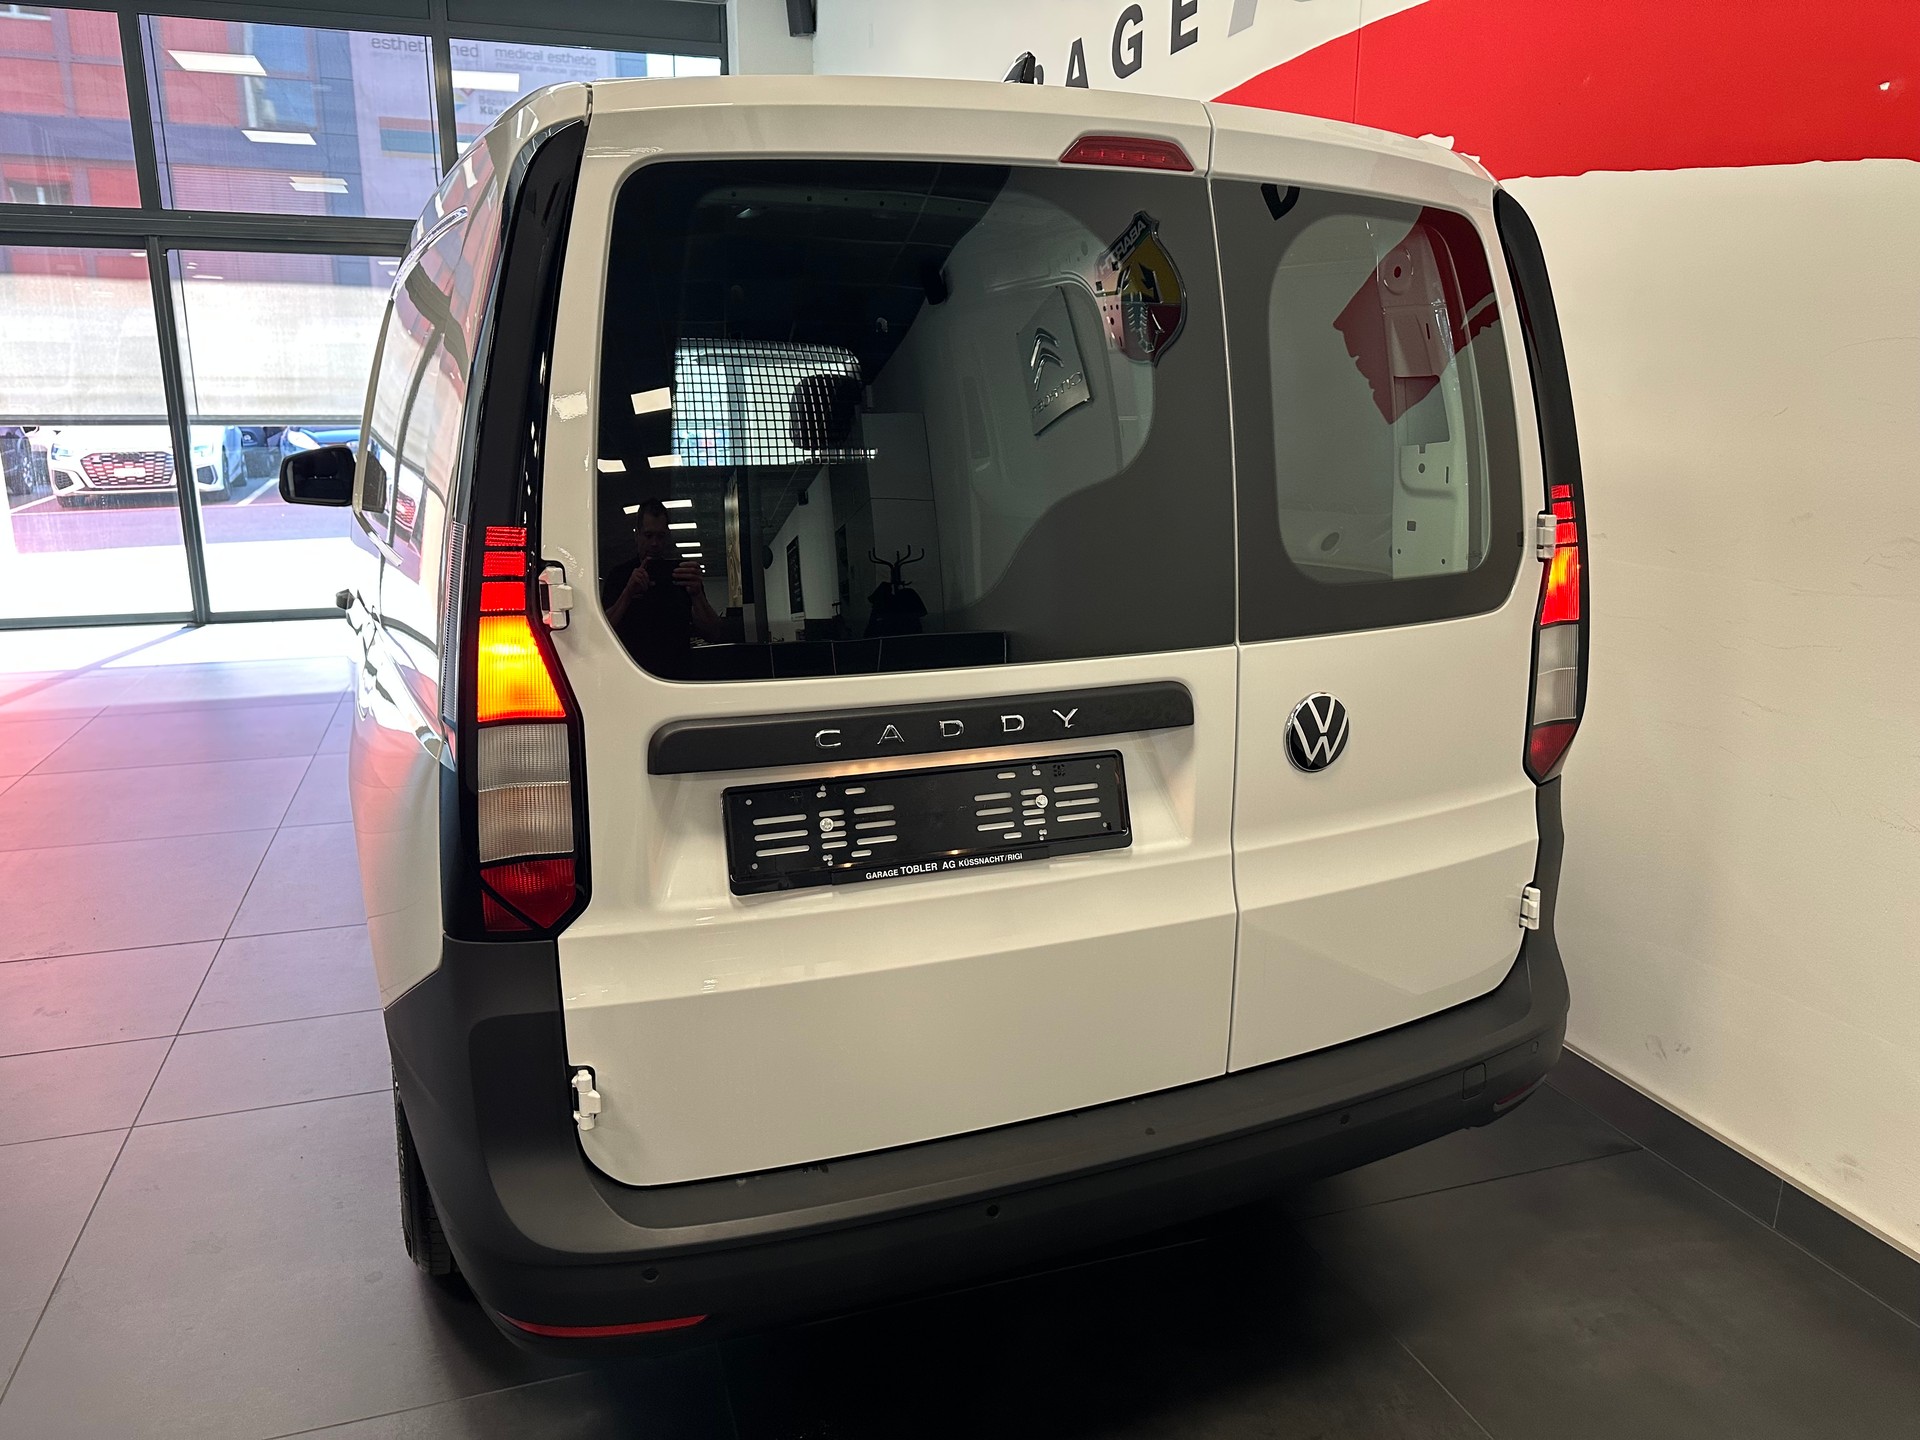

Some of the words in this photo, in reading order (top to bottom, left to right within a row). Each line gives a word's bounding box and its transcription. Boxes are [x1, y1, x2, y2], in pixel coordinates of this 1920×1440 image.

[494, 47, 544, 61] medical
[547, 52, 597, 67] esthetic
[814, 707, 1079, 748] CADDY
[1284, 691, 1349, 773] VW
[865, 868, 899, 880] GARAGE
[899, 862, 938, 875] TOBLER
[942, 860, 956, 870] AG
[958, 852, 1023, 868] KÜSSNACHT/RIGI
